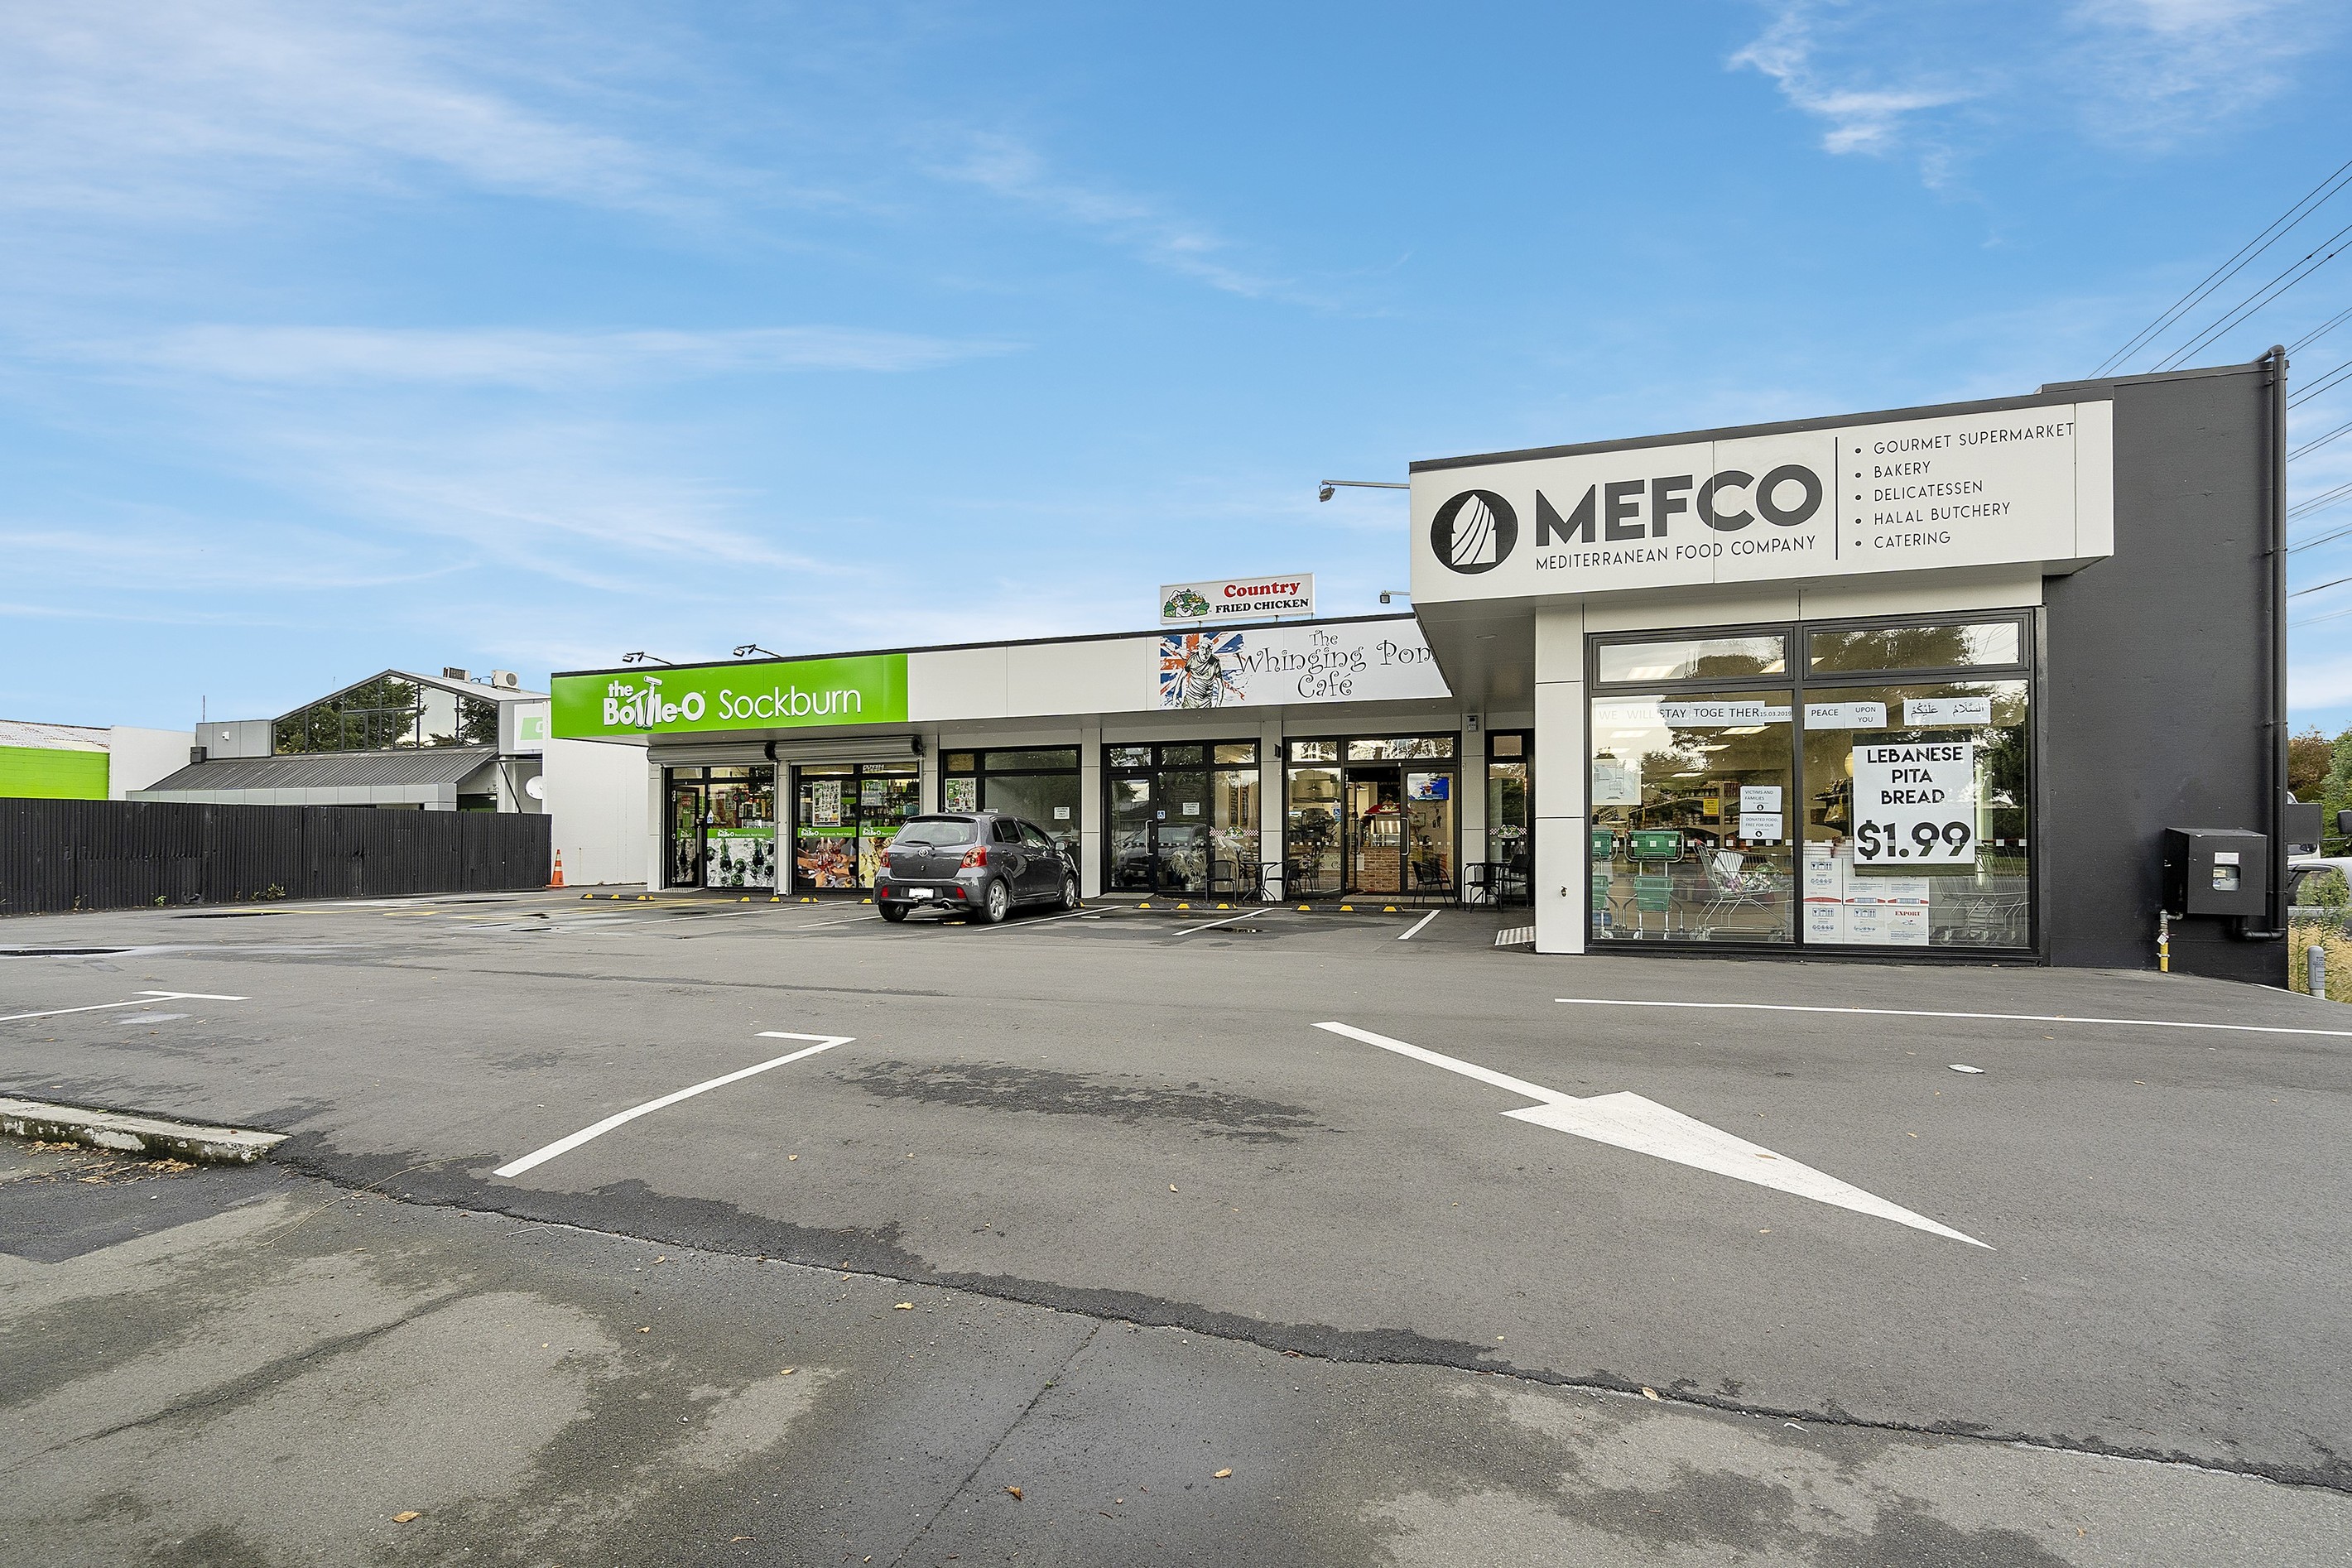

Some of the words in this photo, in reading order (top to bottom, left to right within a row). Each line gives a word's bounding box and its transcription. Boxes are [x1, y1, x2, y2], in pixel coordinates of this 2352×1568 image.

[1873, 435, 1951, 455] GOURMET
[1959, 422, 2074, 446] SUPERMARKET
[1873, 461, 1931, 479] BAKERY
[1873, 479, 1984, 502] DELICATESSEN
[1536, 464, 1824, 547] MEFCO
[1873, 509, 1923, 525] HALAL
[1931, 502, 2011, 521] BUTCHERY
[1873, 531, 1951, 548] CATERING
[1536, 546, 1668, 570] MEDITERRANEAN
[1676, 542, 1723, 560] FOOD
[1730, 535, 1816, 556] COMPANY
[1224, 582, 1301, 598] Country
[1215, 602, 1252, 613] FRIED
[1253, 599, 1309, 611] CHICKEN
[1309, 629, 1339, 646] The
[1235, 646, 1367, 675] Whinging
[608, 680, 633, 697] the
[1297, 671, 1353, 698] Café
[718, 685, 862, 719] Sockburn
[1599, 710, 1618, 719] WE
[1626, 709, 1654, 719] WILL
[1659, 709, 1686, 718] STAY
[1811, 709, 1839, 717] PEACE
[1867, 746, 1964, 764] LEBANESE
[1892, 768, 1933, 784] PITA
[1881, 789, 1946, 805] BREAD
[1857, 820, 1971, 861] $1.99
